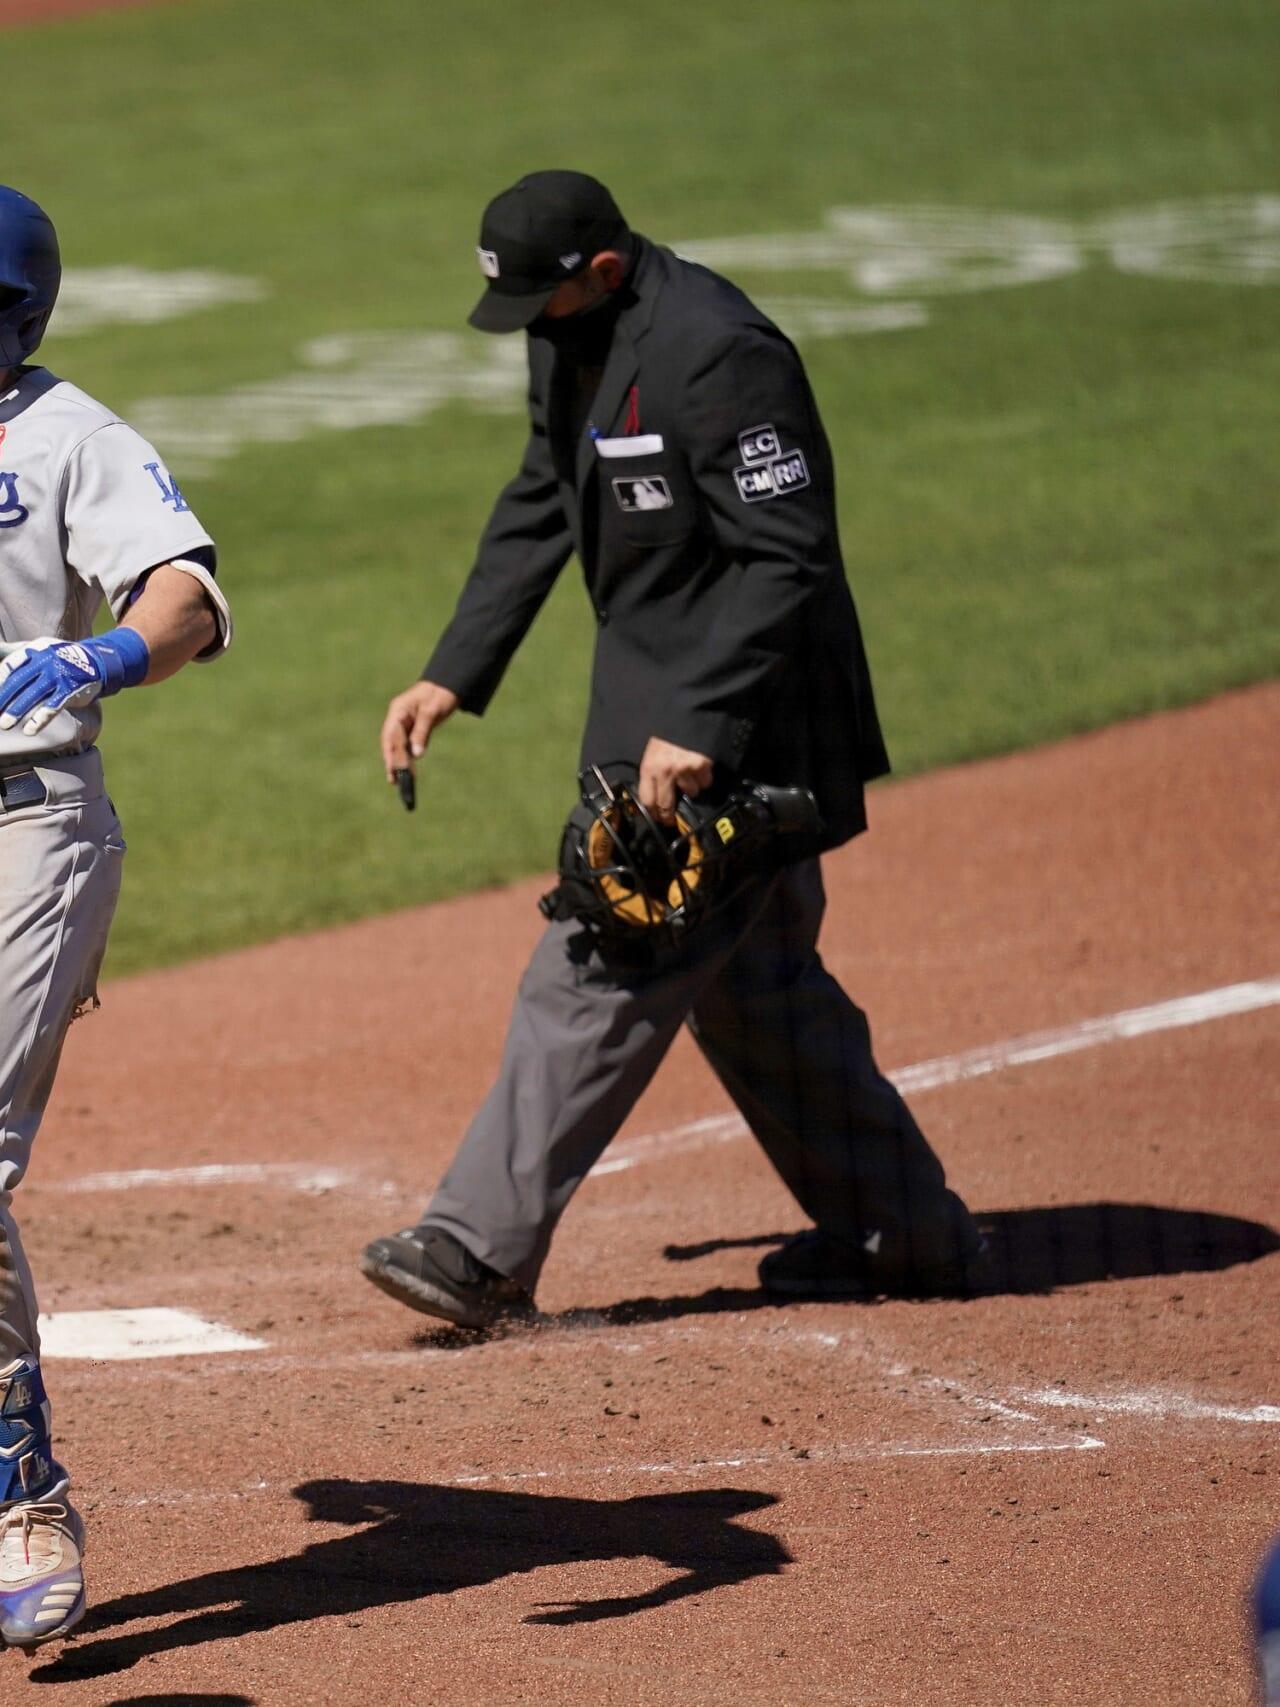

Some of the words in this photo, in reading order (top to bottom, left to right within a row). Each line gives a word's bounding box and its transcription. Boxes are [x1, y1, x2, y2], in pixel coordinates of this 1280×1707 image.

[743, 432, 774, 457] EC
[740, 470, 773, 493] CM
[774, 459, 804, 485] RR
[55, 648, 96, 676] adidas
[14, 1382, 31, 1407] LA
[34, 1453, 49, 1479] LA
